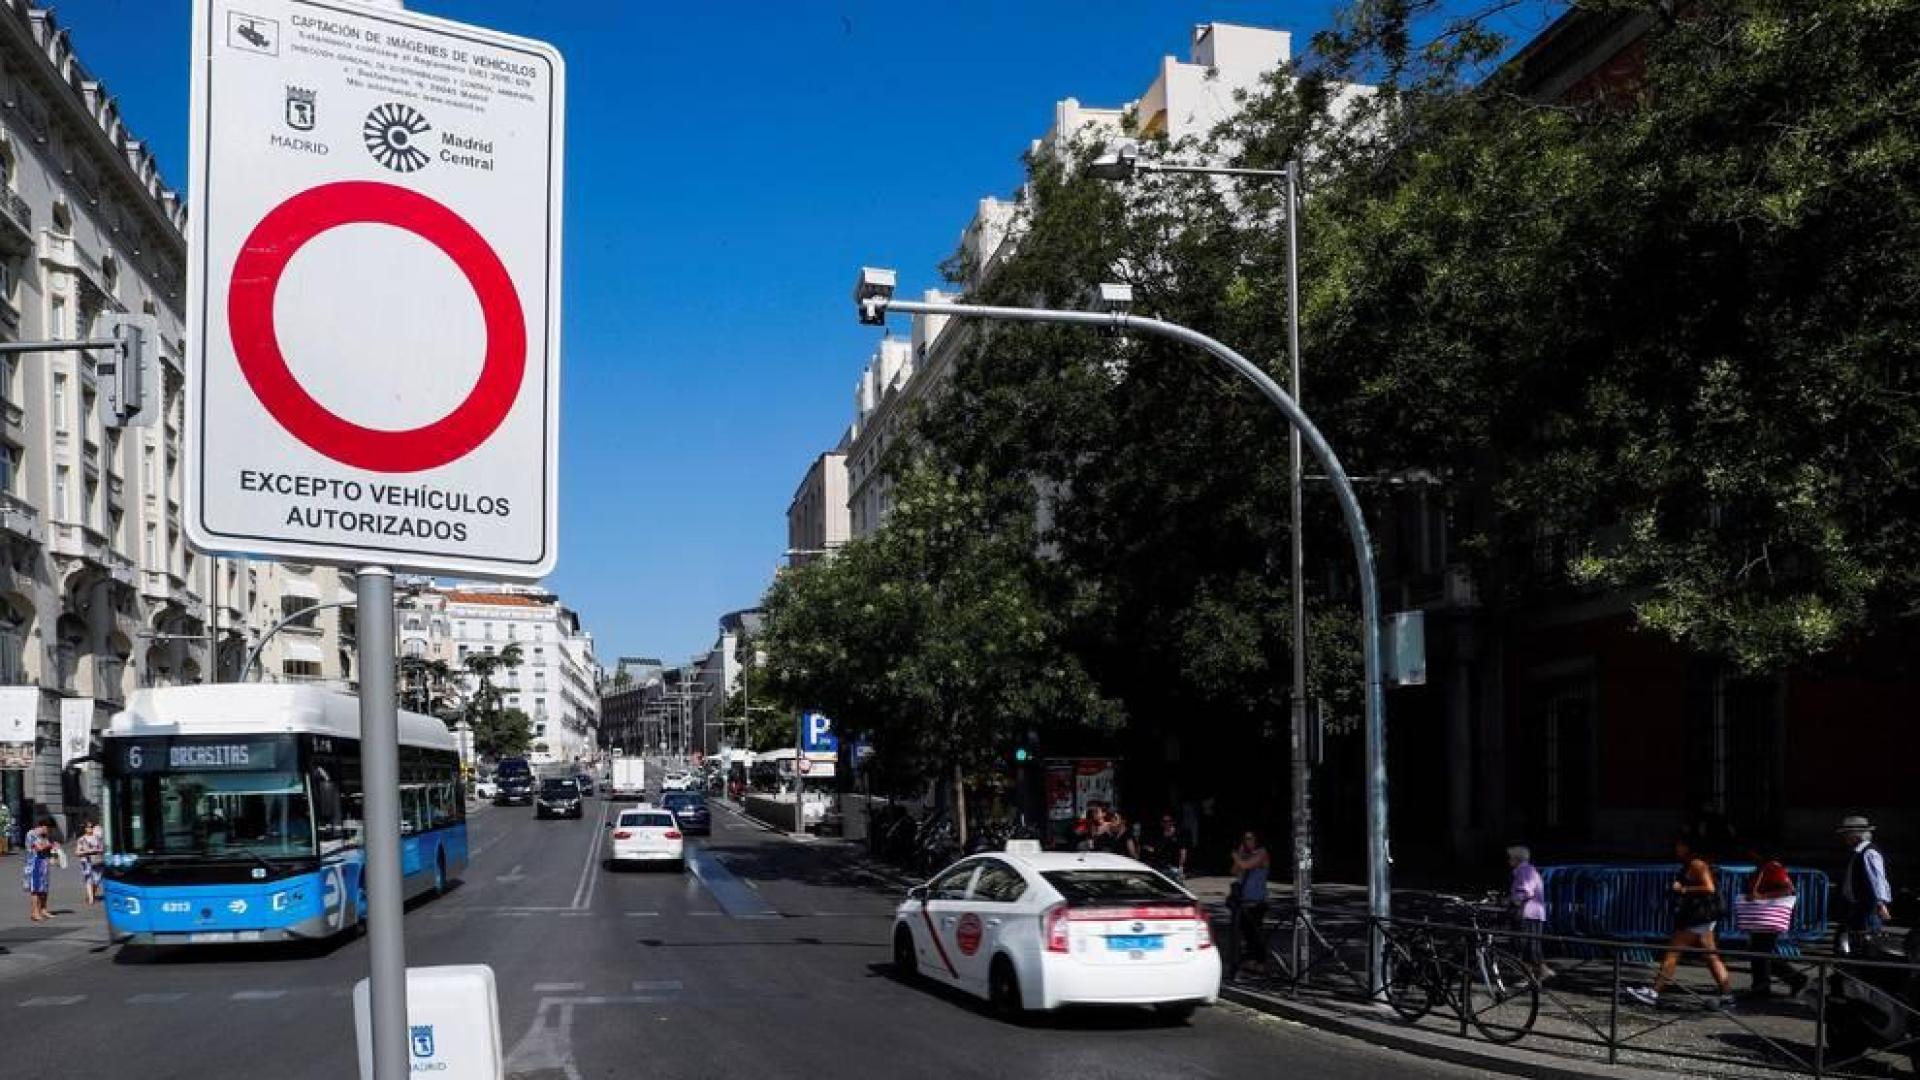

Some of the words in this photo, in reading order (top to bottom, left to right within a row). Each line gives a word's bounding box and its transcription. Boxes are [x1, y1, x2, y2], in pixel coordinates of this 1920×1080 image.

[365, 30, 380, 43] DE
[452, 49, 467, 62] DE
[270, 134, 329, 156] MADRID
[441, 131, 494, 154] Madrid
[439, 148, 495, 171] Central
[240, 470, 362, 501] EXCEPTO
[369, 483, 511, 516] VEHÍCULOS
[286, 506, 467, 541] AUTORIZADOS
[810, 712, 832, 746] P
[129, 746, 143, 769] 6
[169, 744, 249, 767] ORCASITAS
